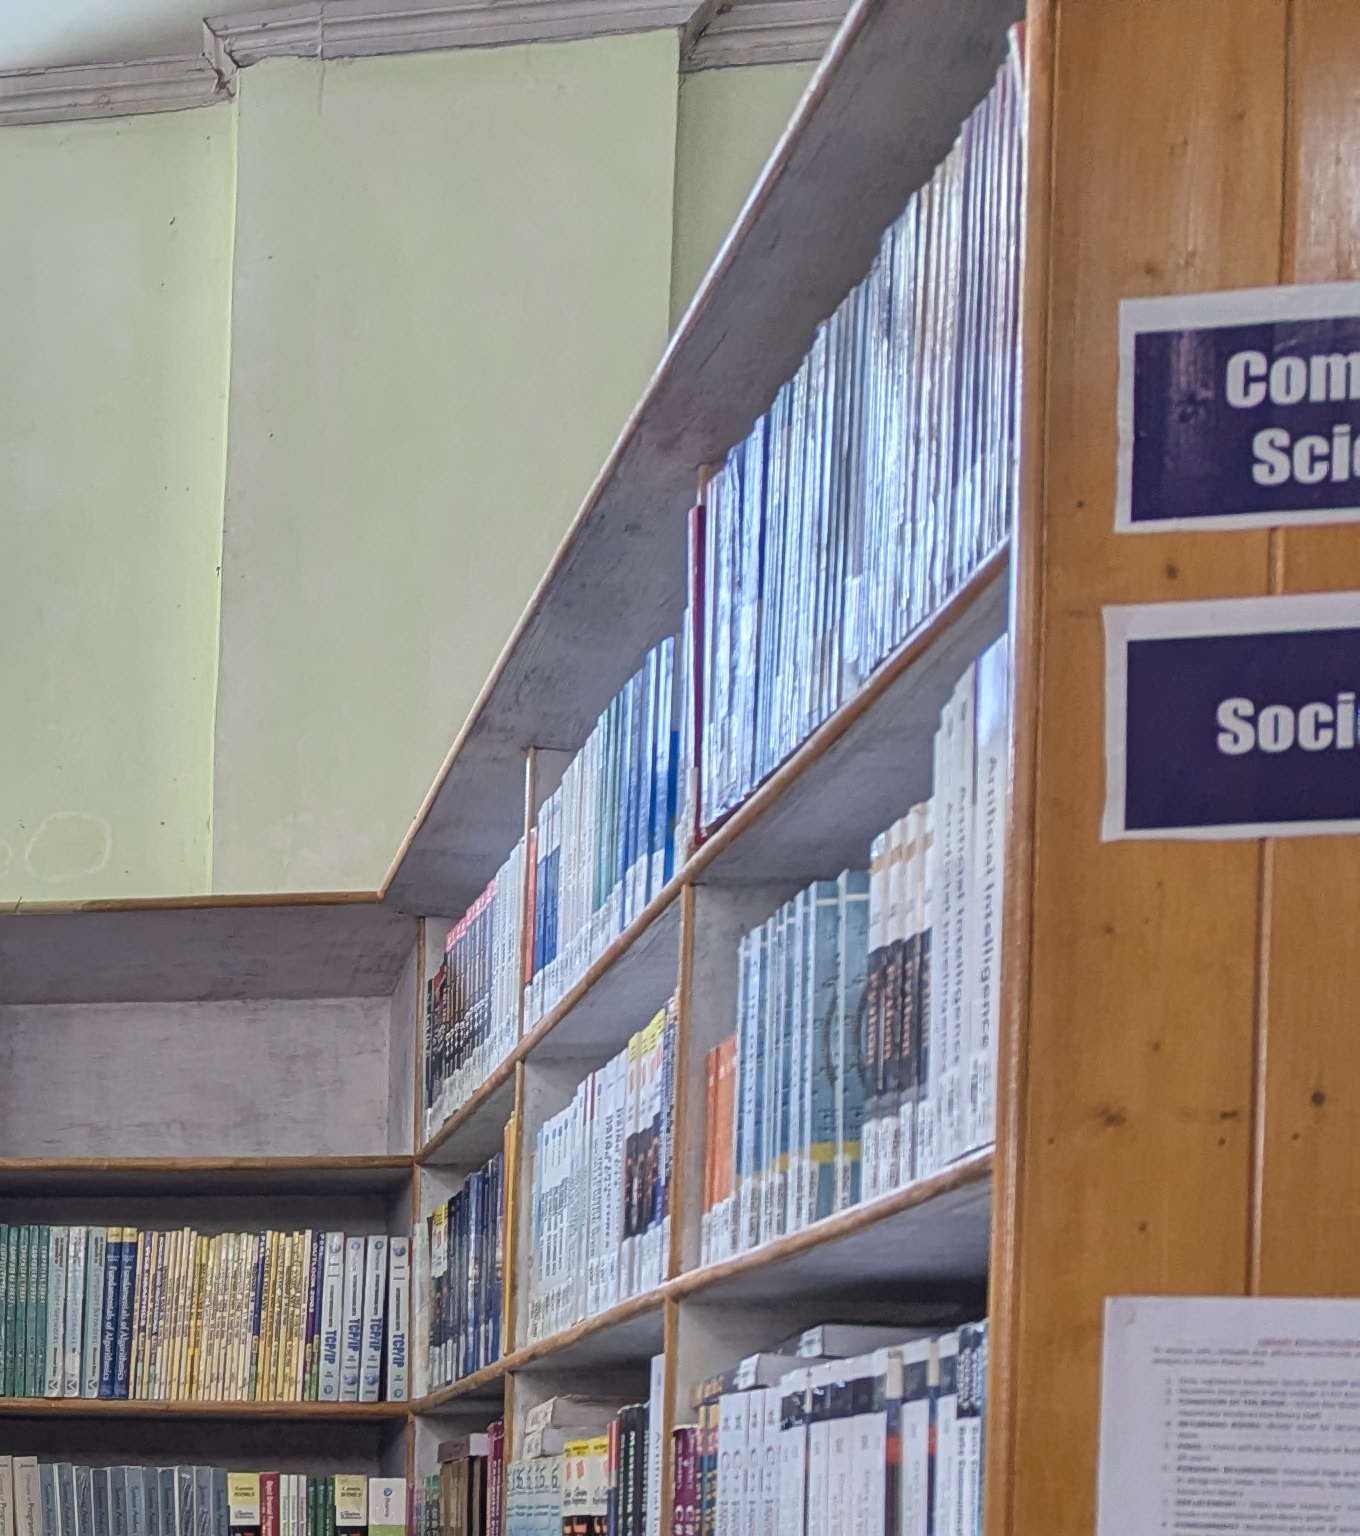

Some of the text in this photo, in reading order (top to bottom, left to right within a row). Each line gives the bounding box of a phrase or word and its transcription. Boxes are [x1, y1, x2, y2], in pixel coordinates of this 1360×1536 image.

[1226, 350, 1360, 409] Com
[1252, 424, 1360, 487] Sci
[1217, 692, 1360, 755] Soci
[120, 1266, 132, 1320] Fundamentals
[324, 1330, 337, 1364] TCP/IP
[369, 1318, 382, 1351] TCP/IP
[392, 1333, 405, 1368] TCP/IP
